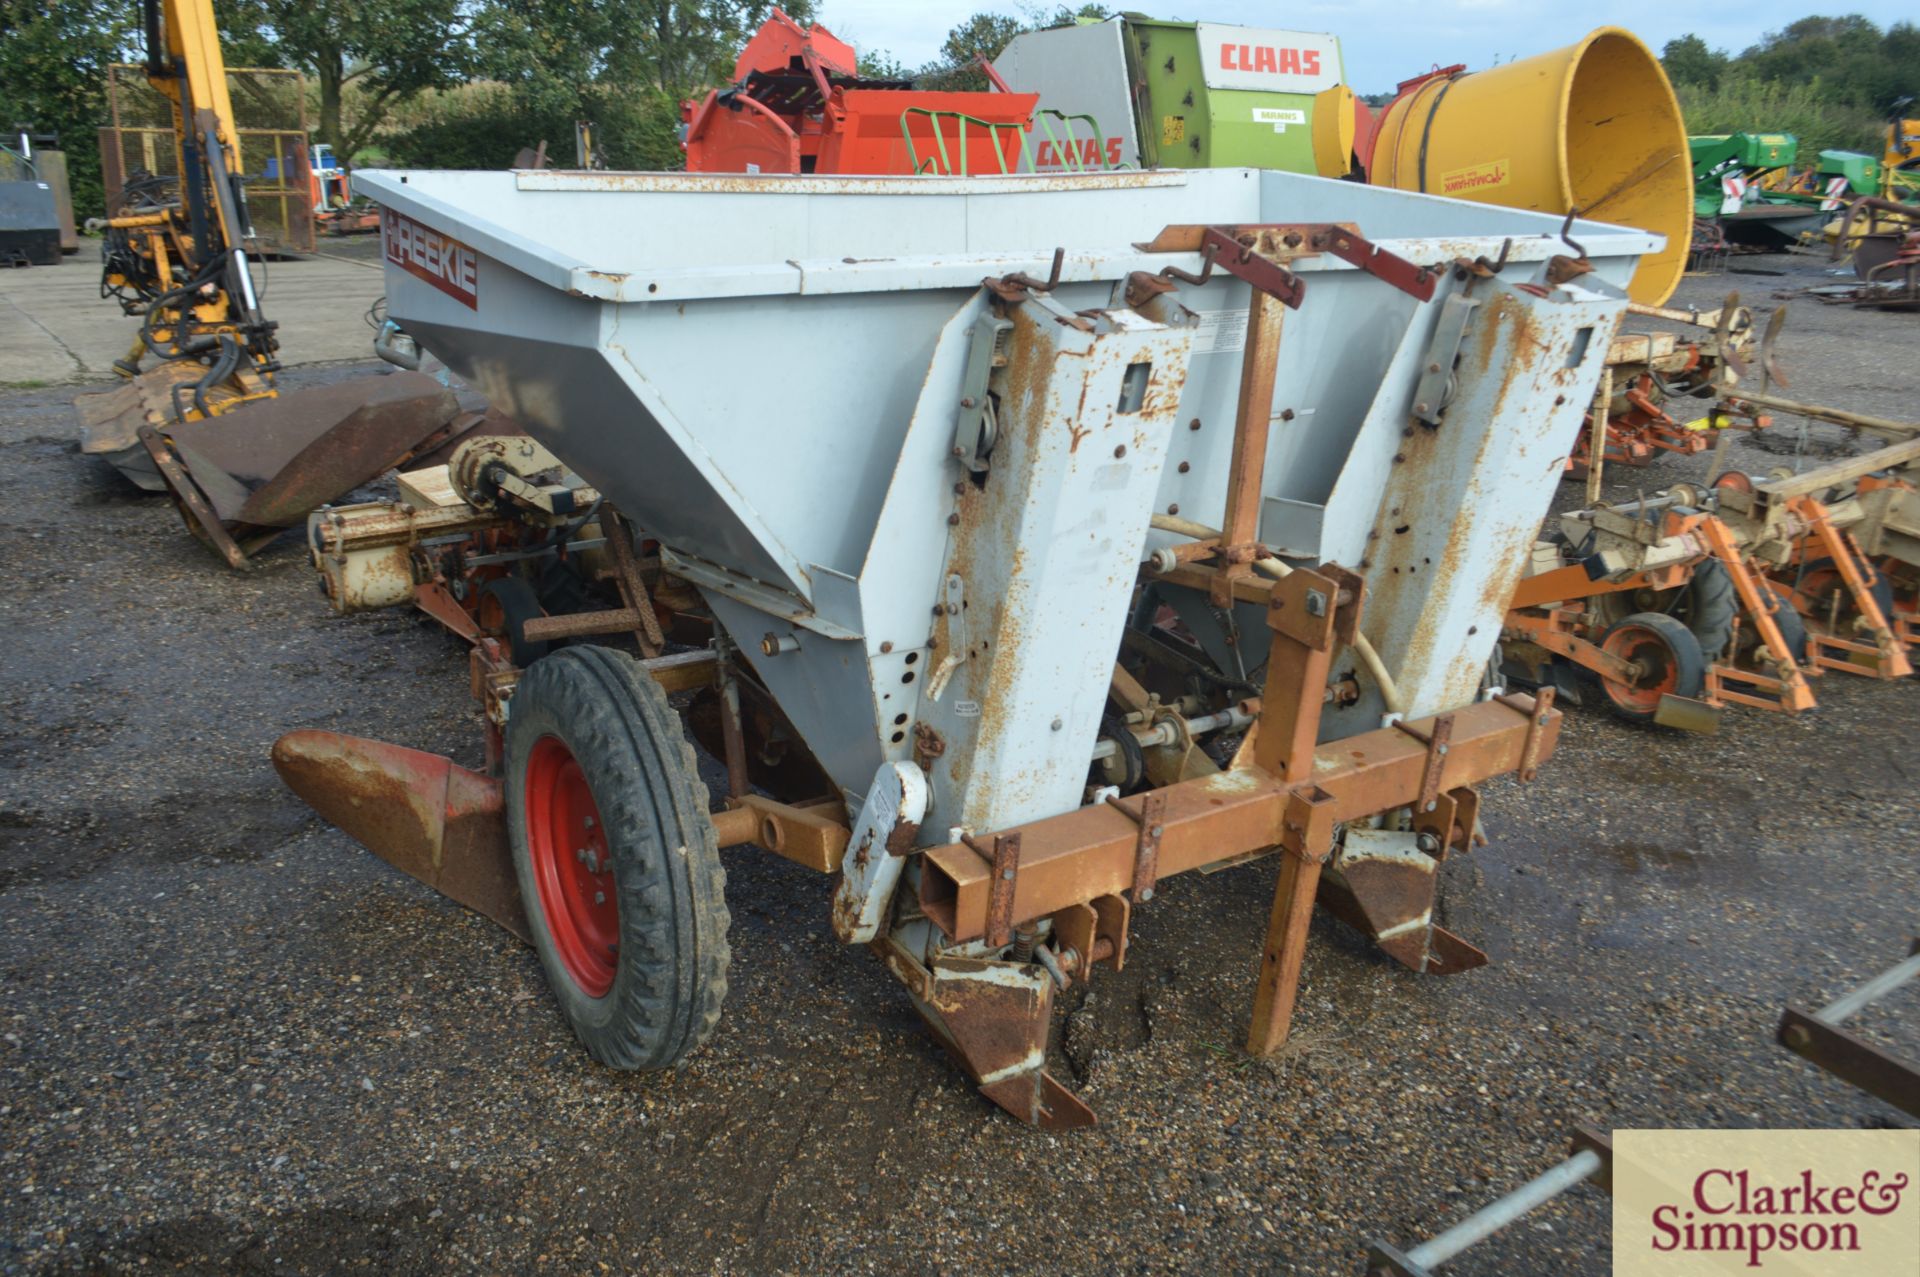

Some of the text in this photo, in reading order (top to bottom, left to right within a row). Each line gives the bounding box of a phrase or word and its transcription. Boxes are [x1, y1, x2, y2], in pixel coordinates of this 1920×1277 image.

[1220, 43, 1321, 76] CLAAS
[1261, 111, 1297, 121] MANNS
[1036, 137, 1124, 166] CLAAS
[399, 217, 476, 296] REEKIE
